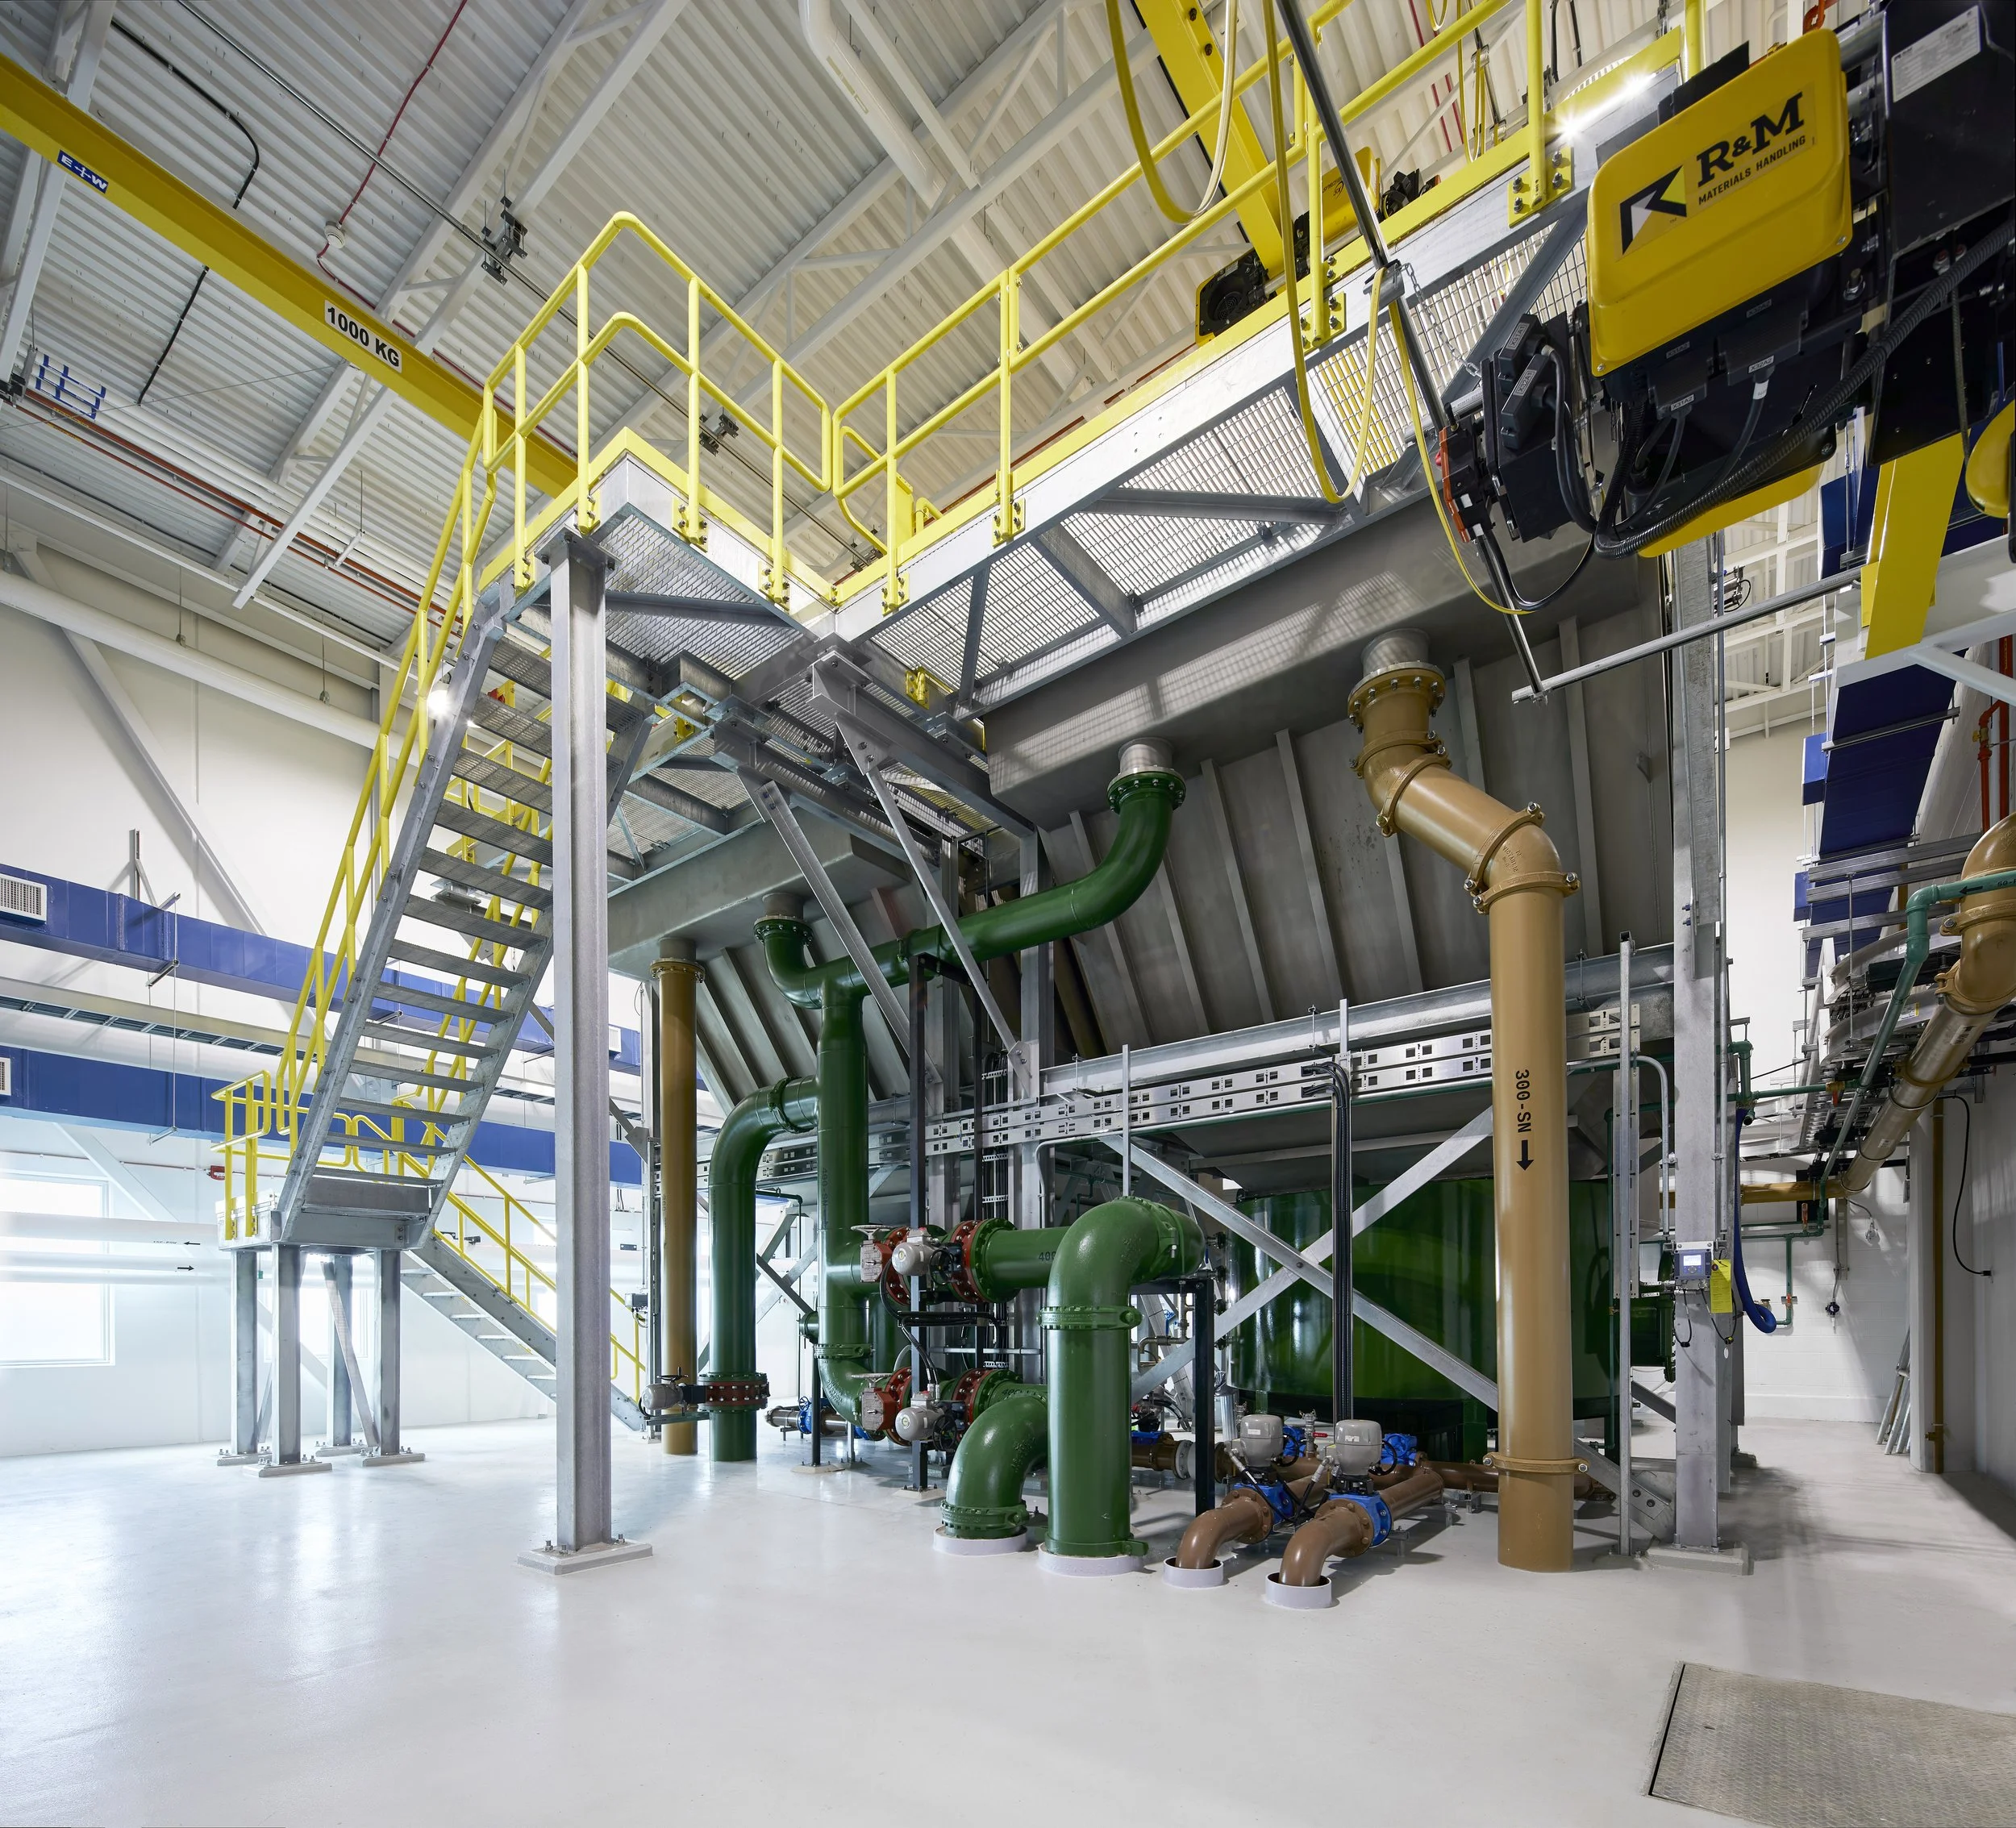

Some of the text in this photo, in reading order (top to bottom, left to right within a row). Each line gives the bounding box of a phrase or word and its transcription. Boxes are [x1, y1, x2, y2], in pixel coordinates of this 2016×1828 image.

[1697, 91, 1804, 188] R&M
[61, 155, 108, 189] E W
[1698, 135, 1806, 206] MATERIALS HANDLING
[327, 306, 399, 367] 1000 KG
[1510, 326, 1526, 346] X31A1
[1752, 357, 1772, 372] X32A2
[1518, 373, 1533, 393] X32A1
[1672, 396, 1693, 410] X31A2
[1515, 1068, 1531, 1133] 300-SN
